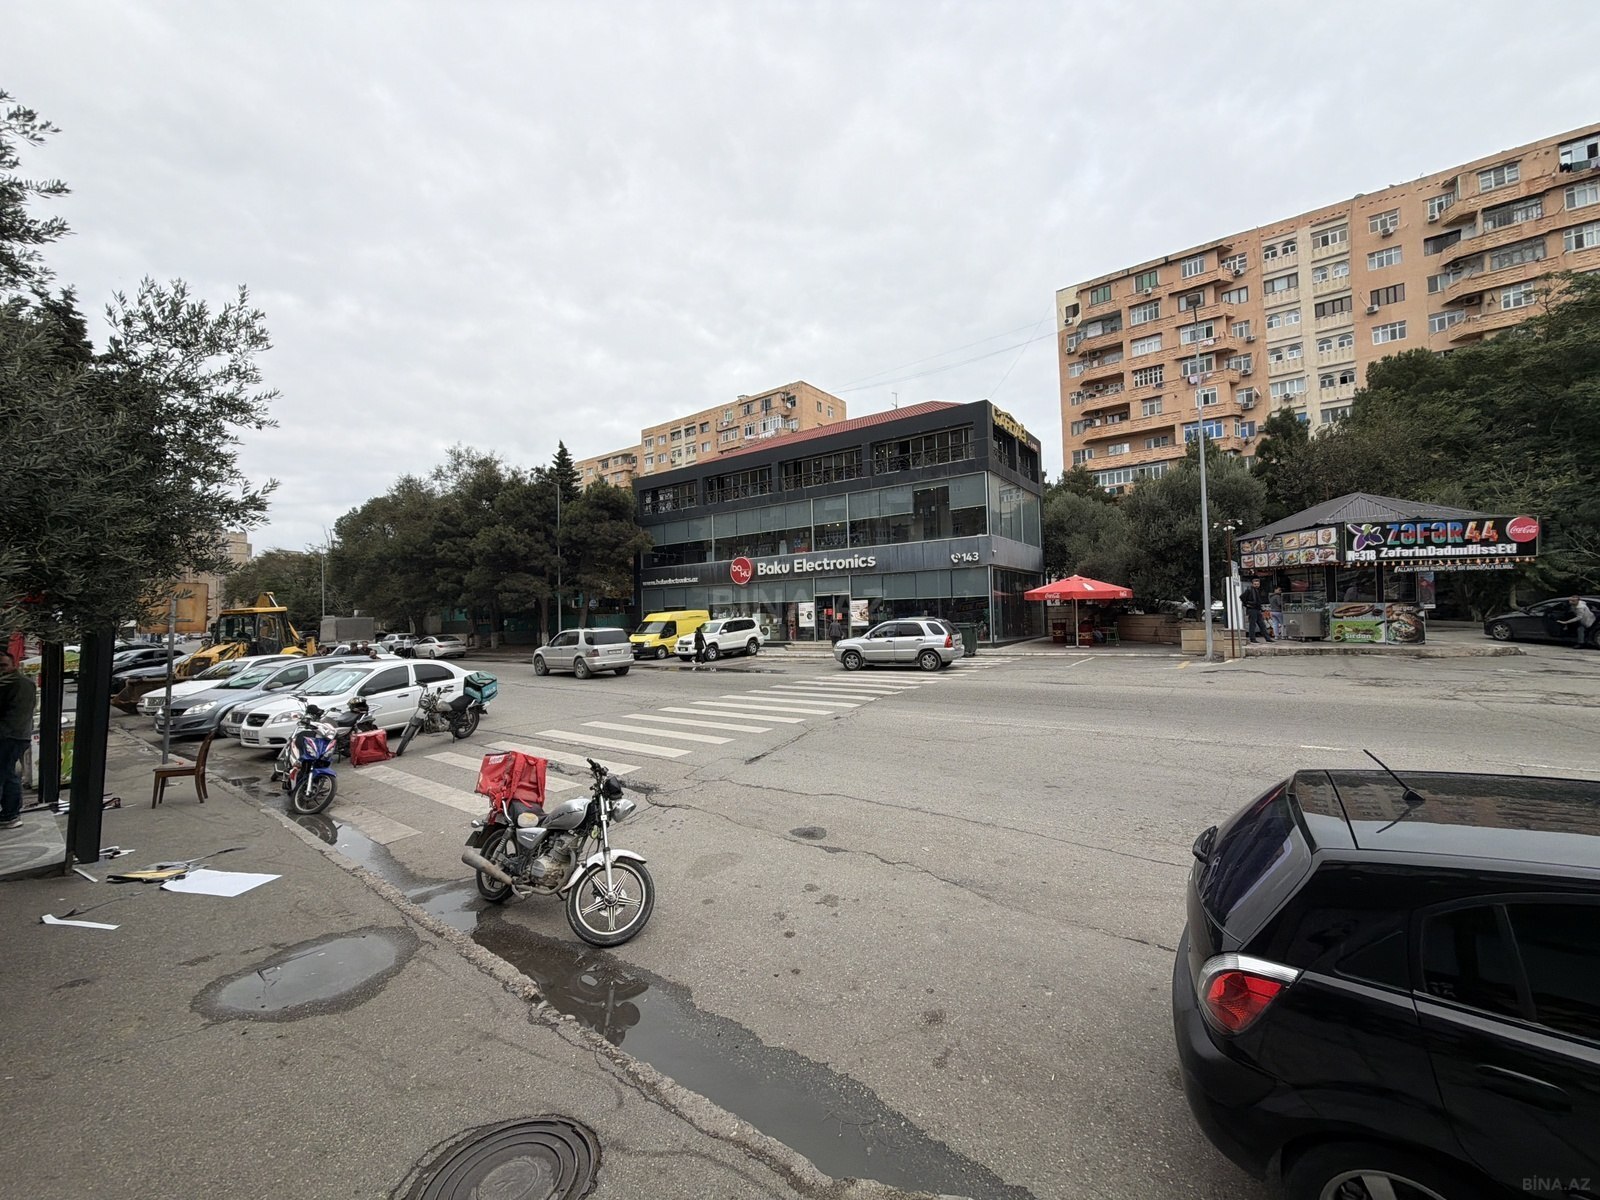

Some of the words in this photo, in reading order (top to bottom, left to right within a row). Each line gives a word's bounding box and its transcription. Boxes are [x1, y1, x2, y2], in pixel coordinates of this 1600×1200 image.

[961, 551, 979, 562] 143
[757, 561, 790, 576] Baku
[794, 554, 876, 573] Electronics
